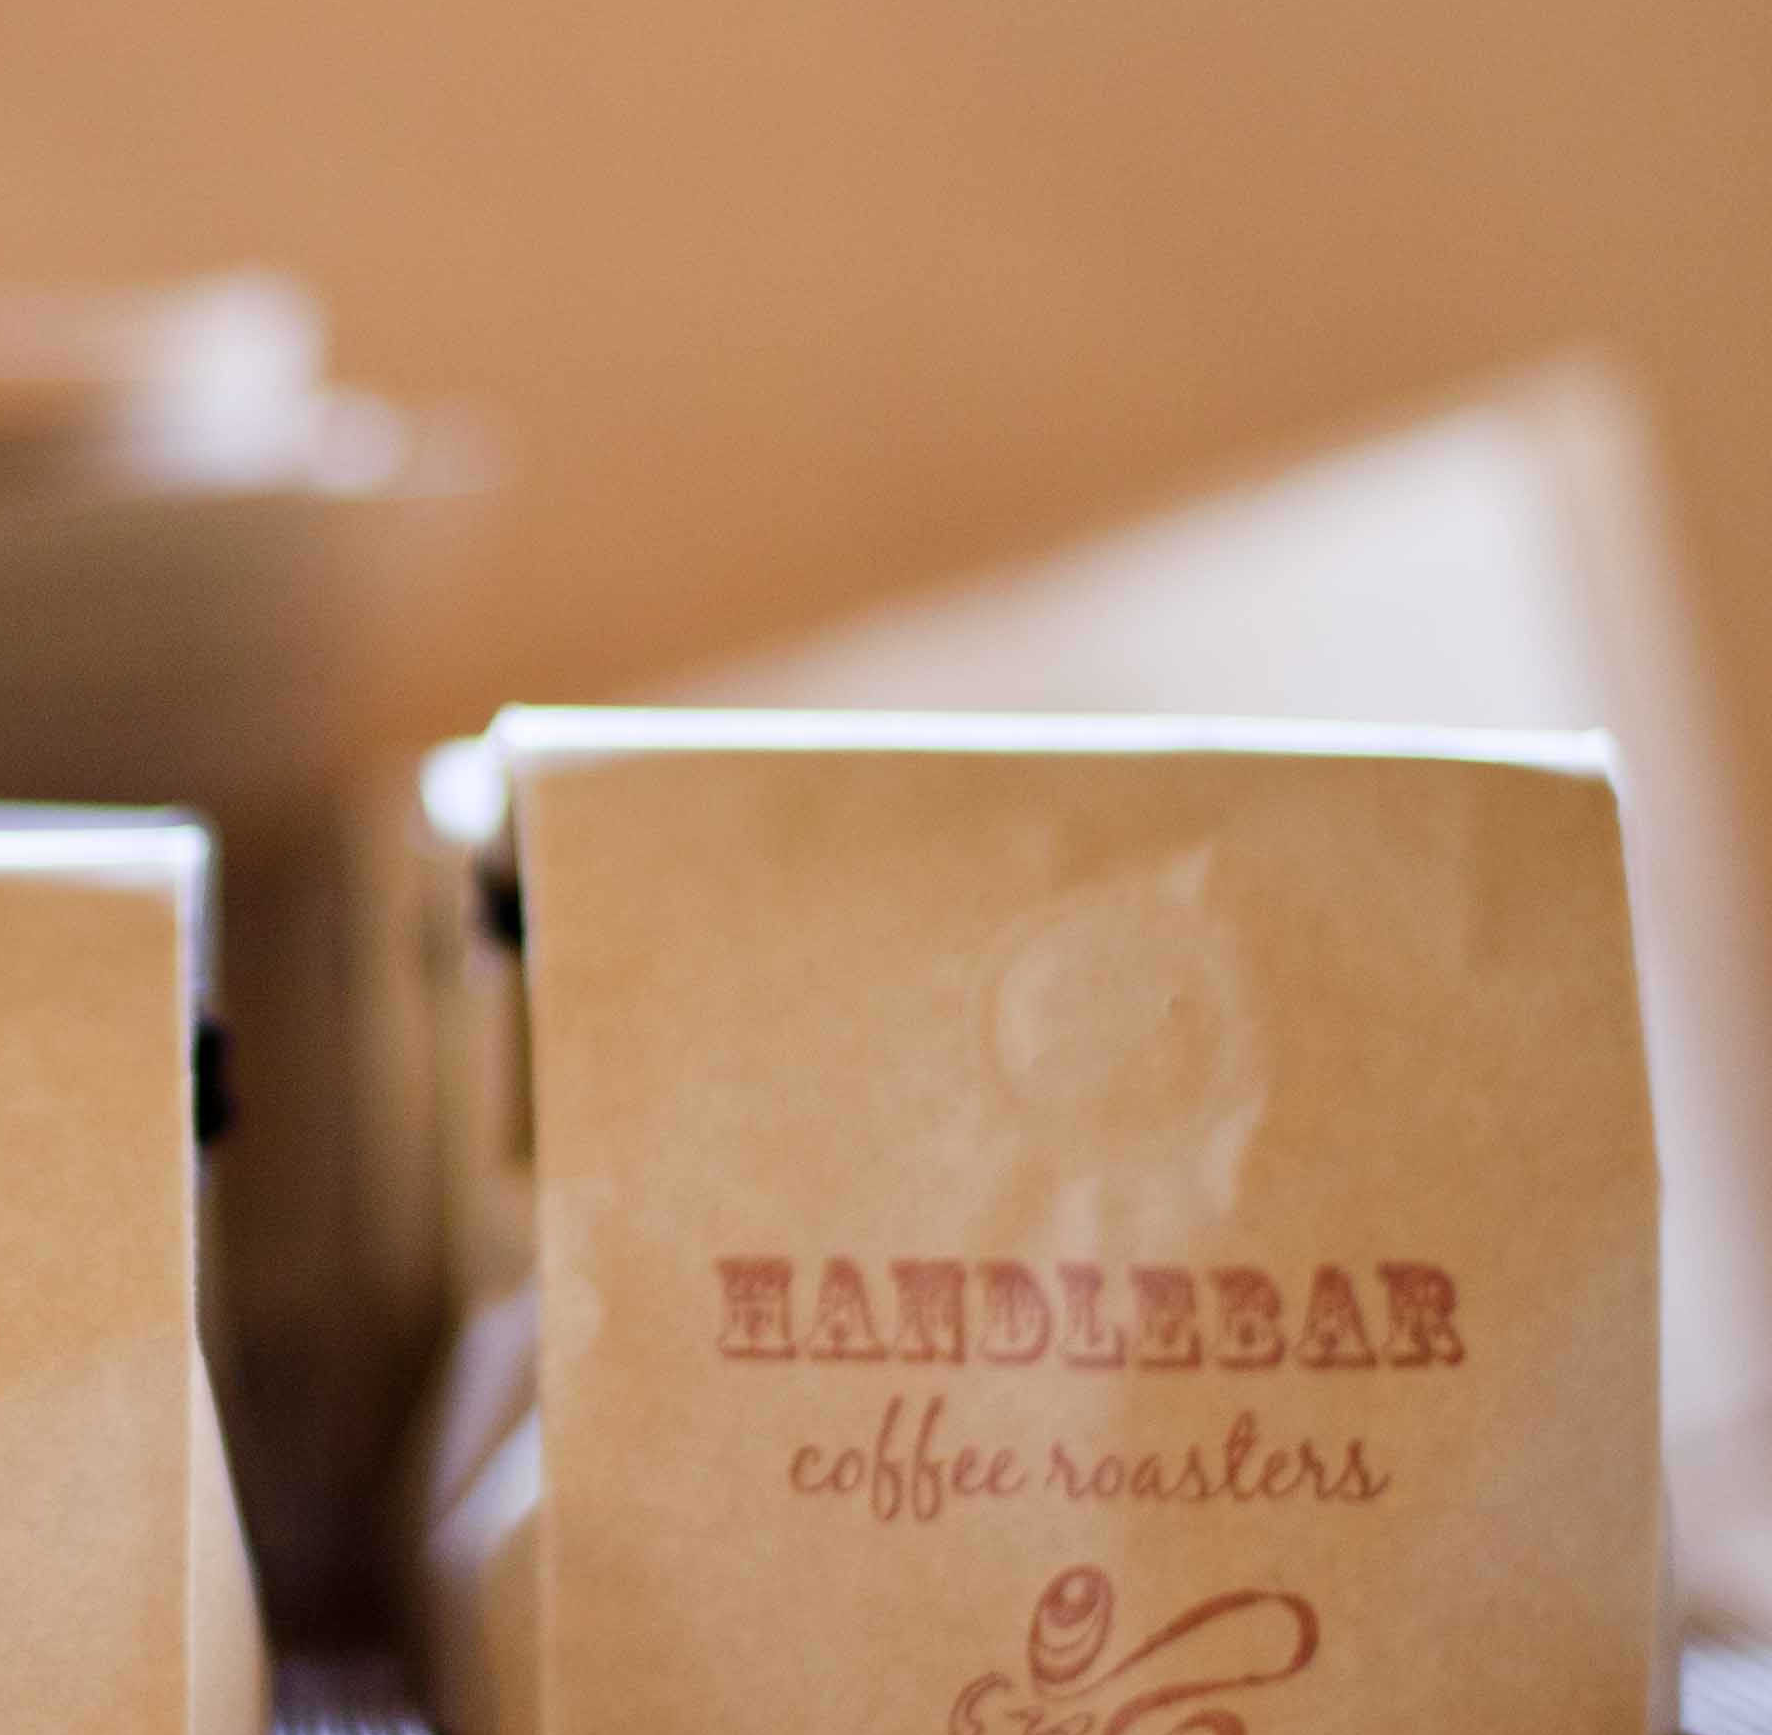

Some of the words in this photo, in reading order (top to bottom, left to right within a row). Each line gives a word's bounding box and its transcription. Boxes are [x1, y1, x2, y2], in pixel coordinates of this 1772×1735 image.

[714, 1257, 1466, 1371] HANDLEBAR
[789, 1396, 1027, 1522] coffee
[1044, 1412, 1390, 1504] roasters
